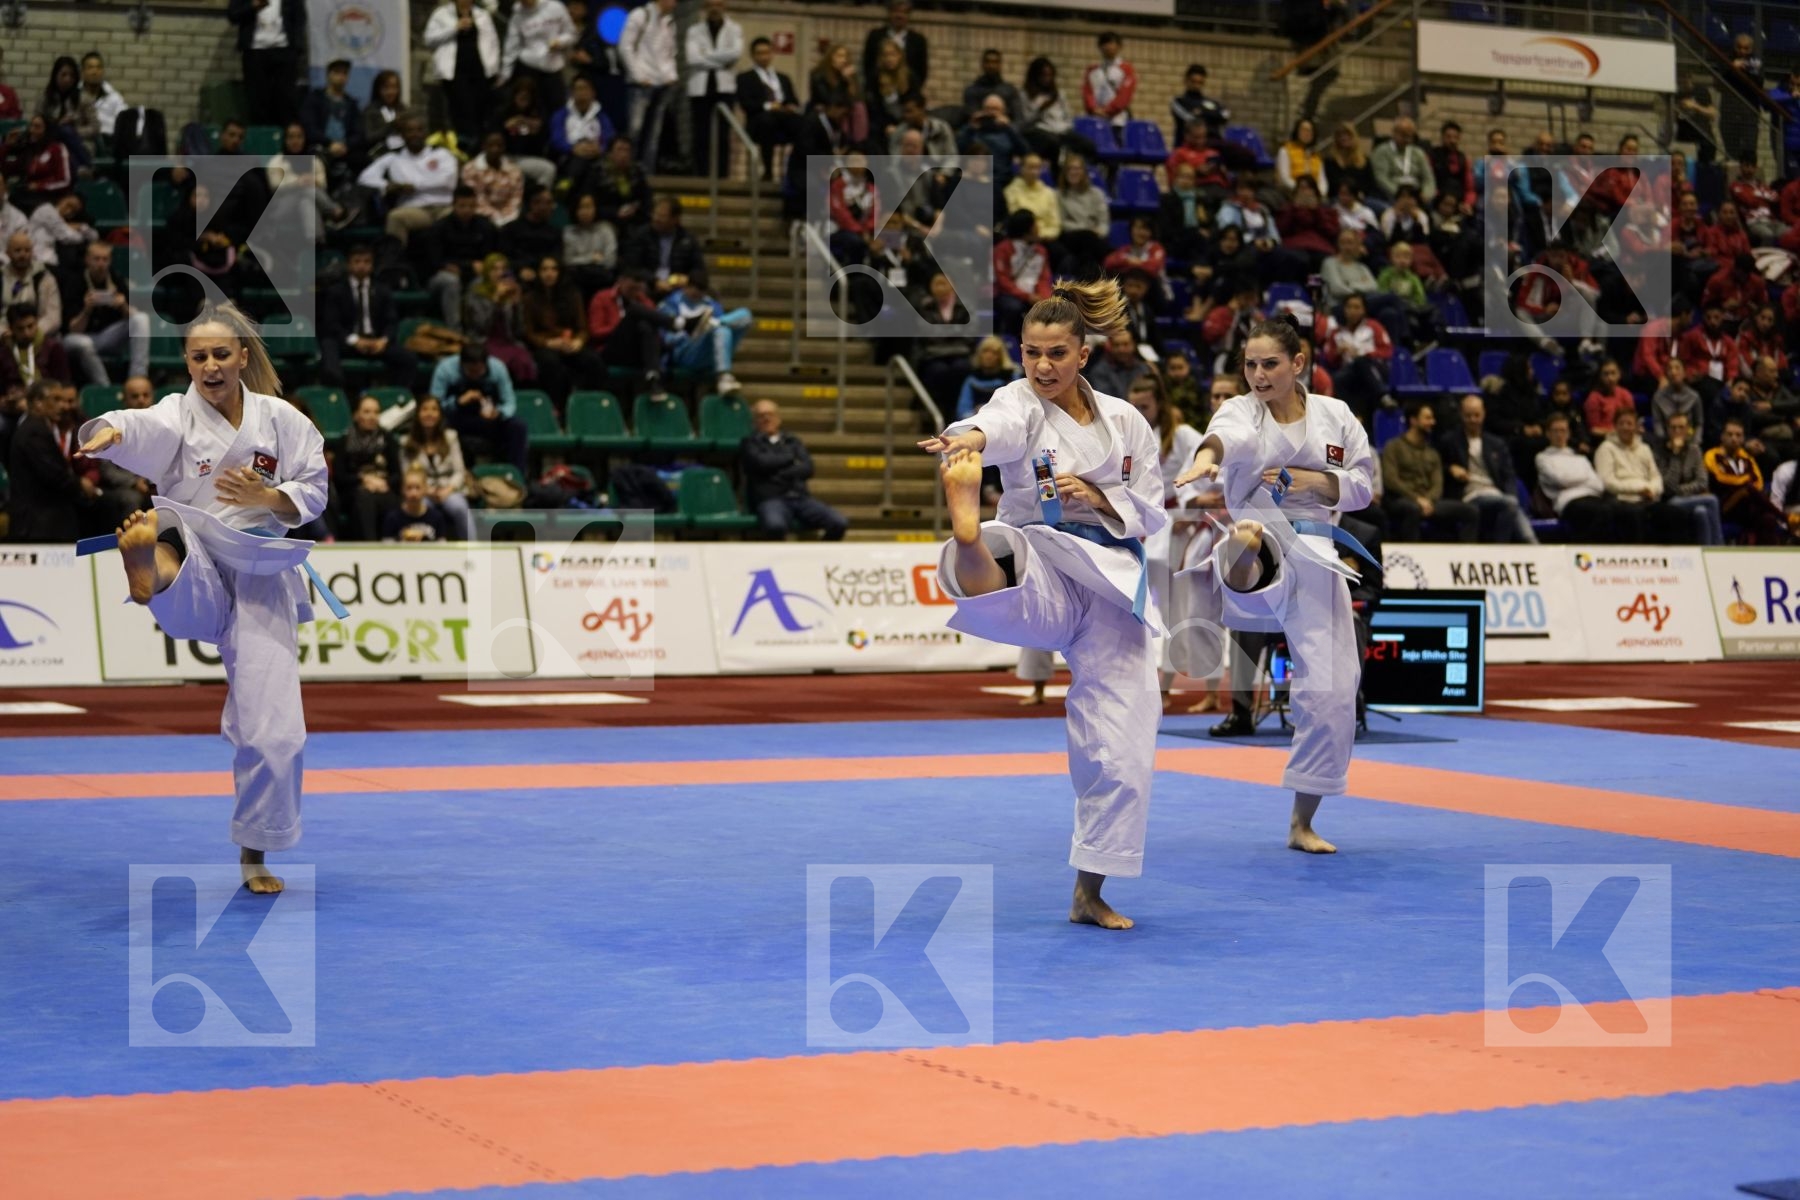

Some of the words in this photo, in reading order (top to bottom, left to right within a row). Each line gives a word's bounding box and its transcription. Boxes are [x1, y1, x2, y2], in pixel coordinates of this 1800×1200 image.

[824, 565, 906, 586] Karate
[1449, 562, 1540, 587] KARATE
[1616, 592, 1671, 632] Aj
[1764, 576, 1800, 623] R
